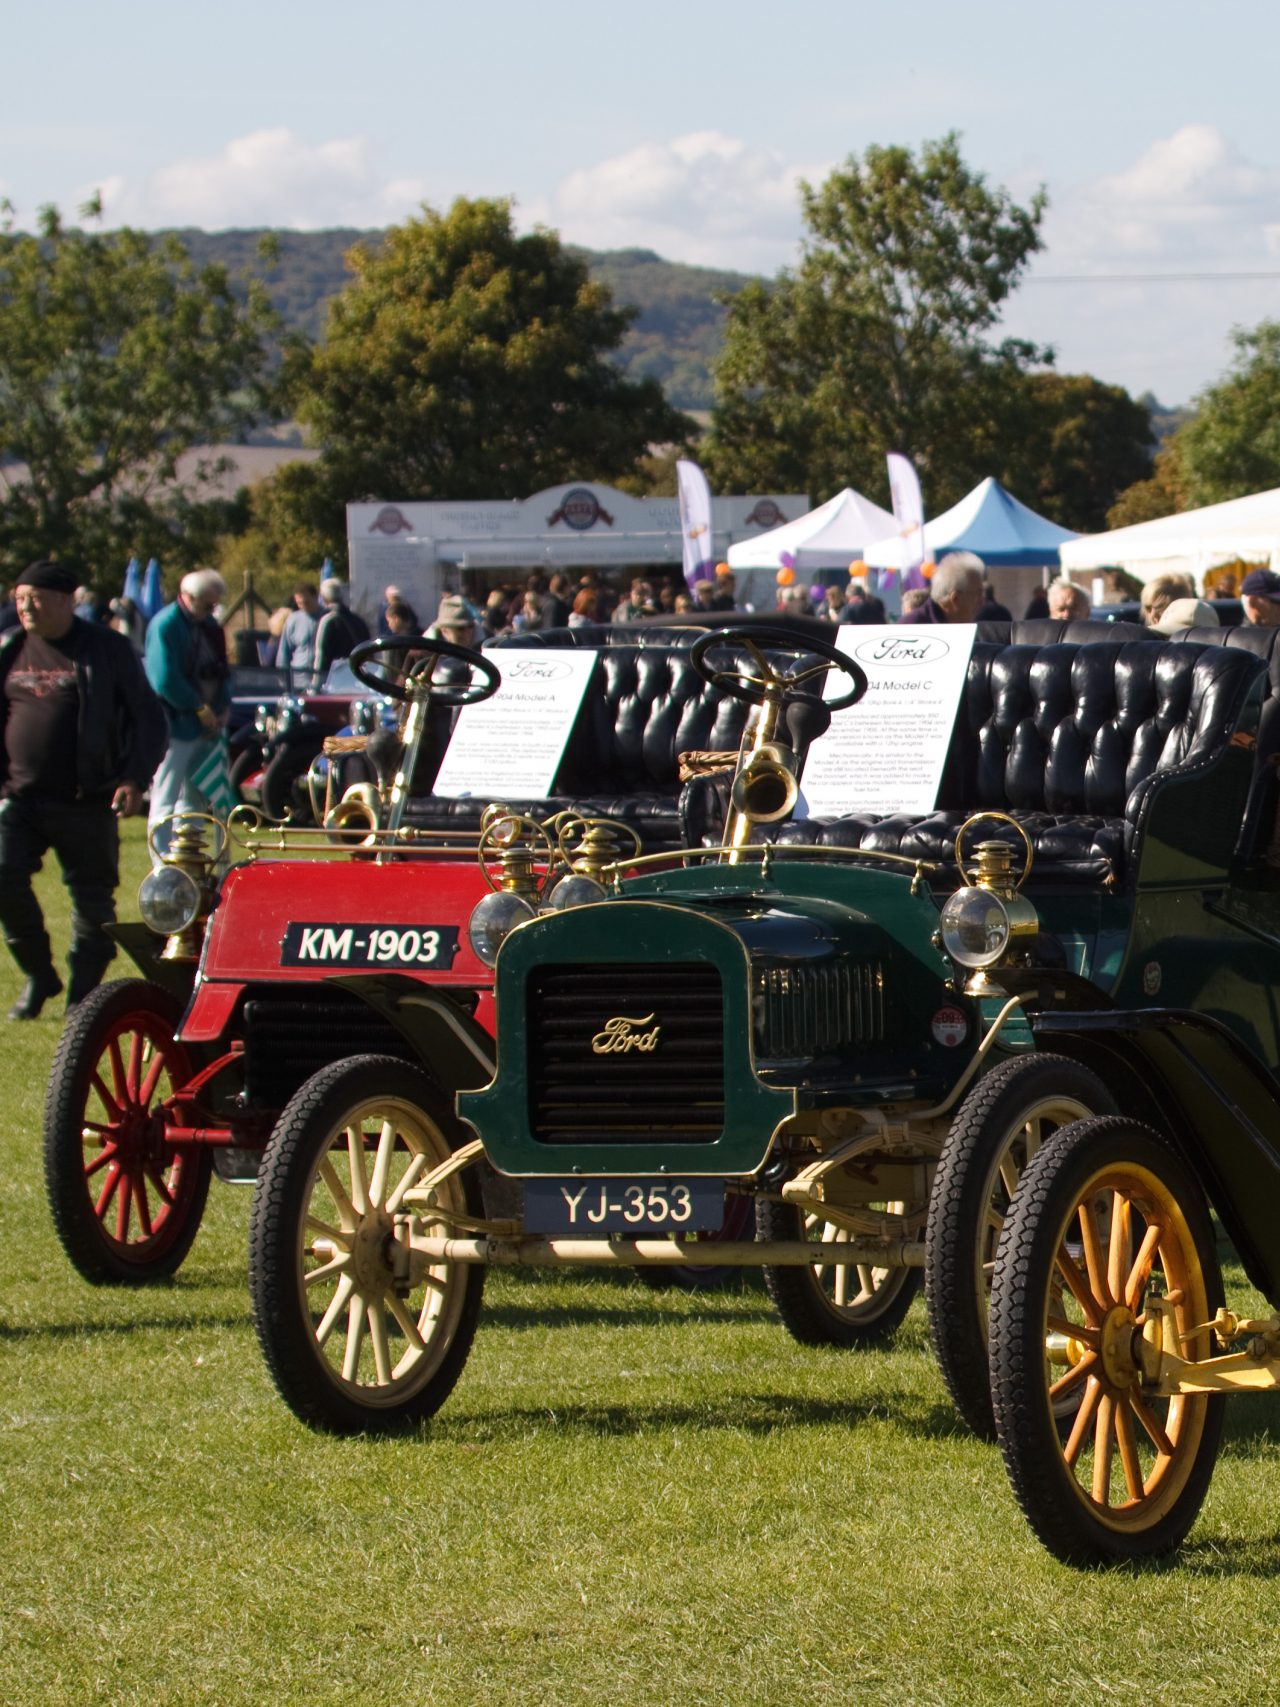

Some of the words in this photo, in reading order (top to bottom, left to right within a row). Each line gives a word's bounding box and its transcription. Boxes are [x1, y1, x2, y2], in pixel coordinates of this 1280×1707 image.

[873, 638, 932, 660] Ford
[509, 660, 558, 678] Ford
[883, 680, 921, 691] Model
[923, 680, 934, 691] C
[298, 928, 440, 962] KM-1903
[591, 1012, 660, 1054] Ford
[560, 1185, 692, 1223] YJ-353
